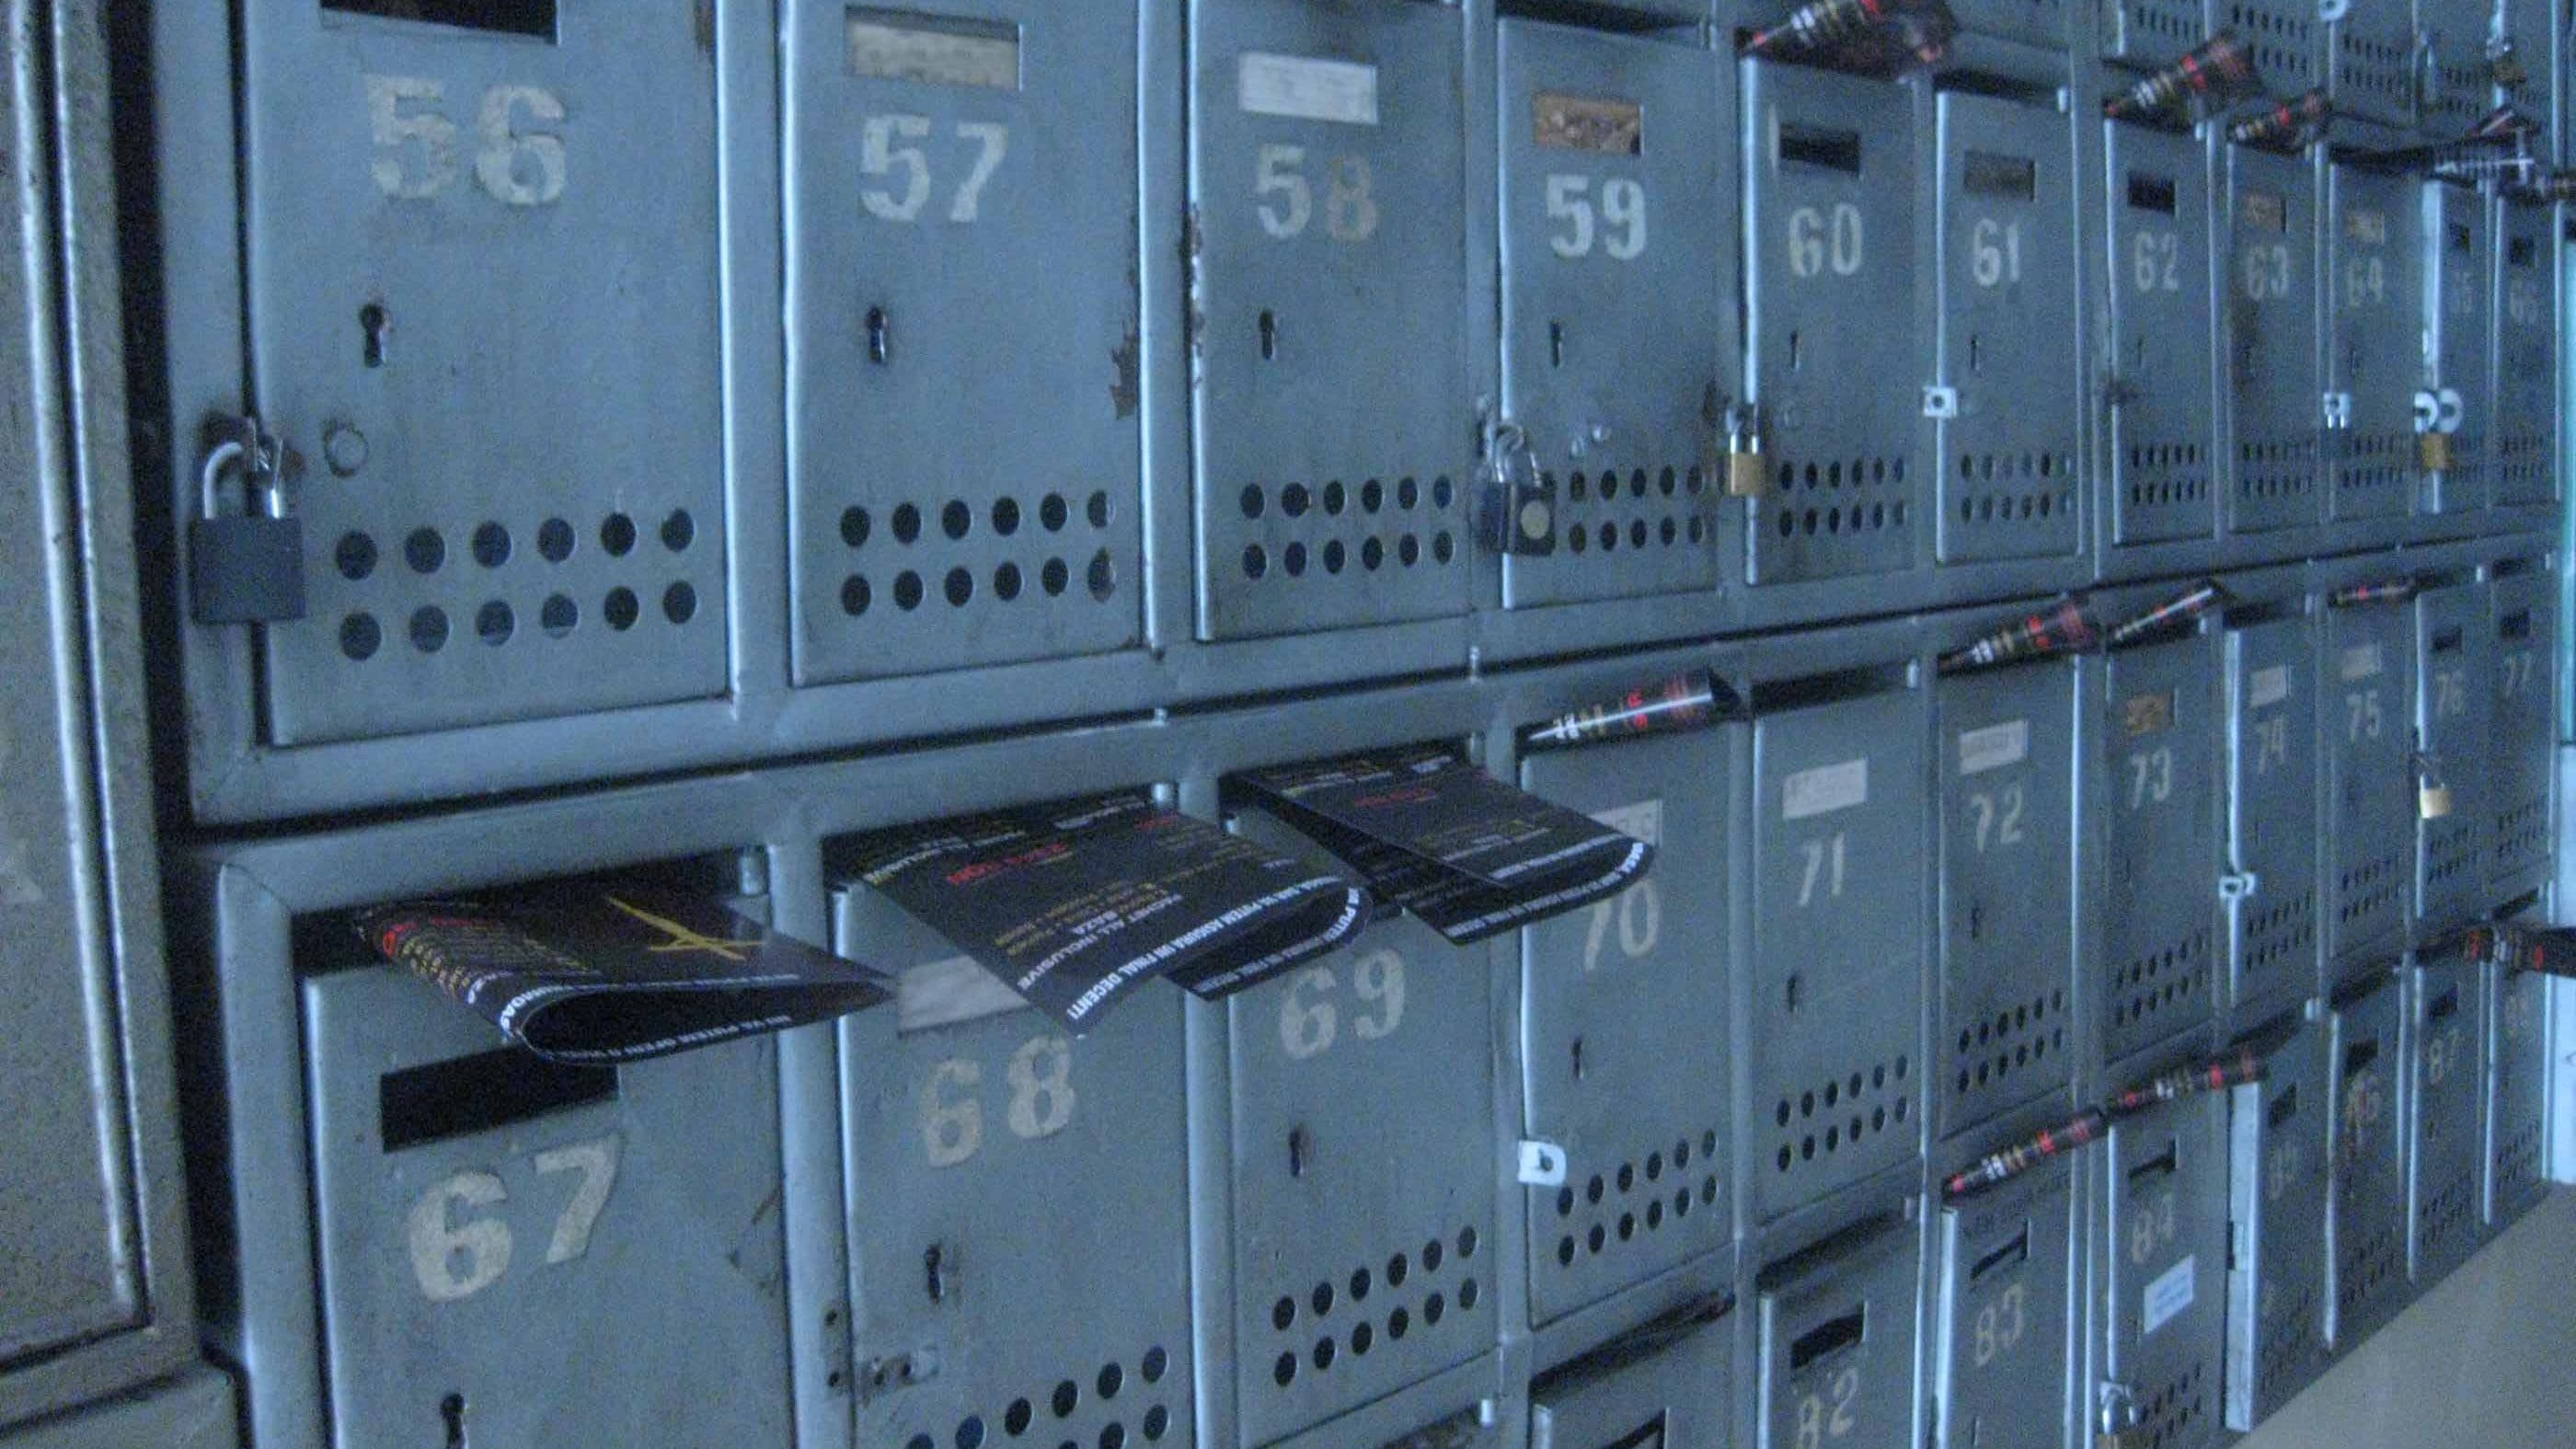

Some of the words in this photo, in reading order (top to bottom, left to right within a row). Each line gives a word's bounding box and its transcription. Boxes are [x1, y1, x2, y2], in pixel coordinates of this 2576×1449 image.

[366, 74, 568, 208] 56
[859, 114, 1008, 223] 57
[1255, 145, 1378, 245] 58
[1547, 173, 1648, 260] 59
[1788, 203, 1862, 277] 60
[1972, 218, 2020, 286] 61
[2134, 231, 2179, 293] 62
[2246, 246, 2290, 301] 63
[2346, 258, 2384, 307] 64
[2345, 690, 2381, 742] 75
[2129, 747, 2172, 810] 73
[1972, 784, 2024, 853] 72
[1799, 832, 1845, 907] 71
[1017, 933, 1099, 991] INCLUSIVE
[1582, 879, 1658, 971] 70
[1066, 972, 1123, 1020] DECENT!
[1118, 953, 1158, 977] FINAL
[1280, 949, 1405, 1059] 69
[923, 1036, 1076, 1168] 68
[408, 1133, 623, 1303] 67
[2132, 1194, 2173, 1264] 84
[1976, 1283, 2025, 1367] 83
[1796, 1367, 1858, 1449] 82
